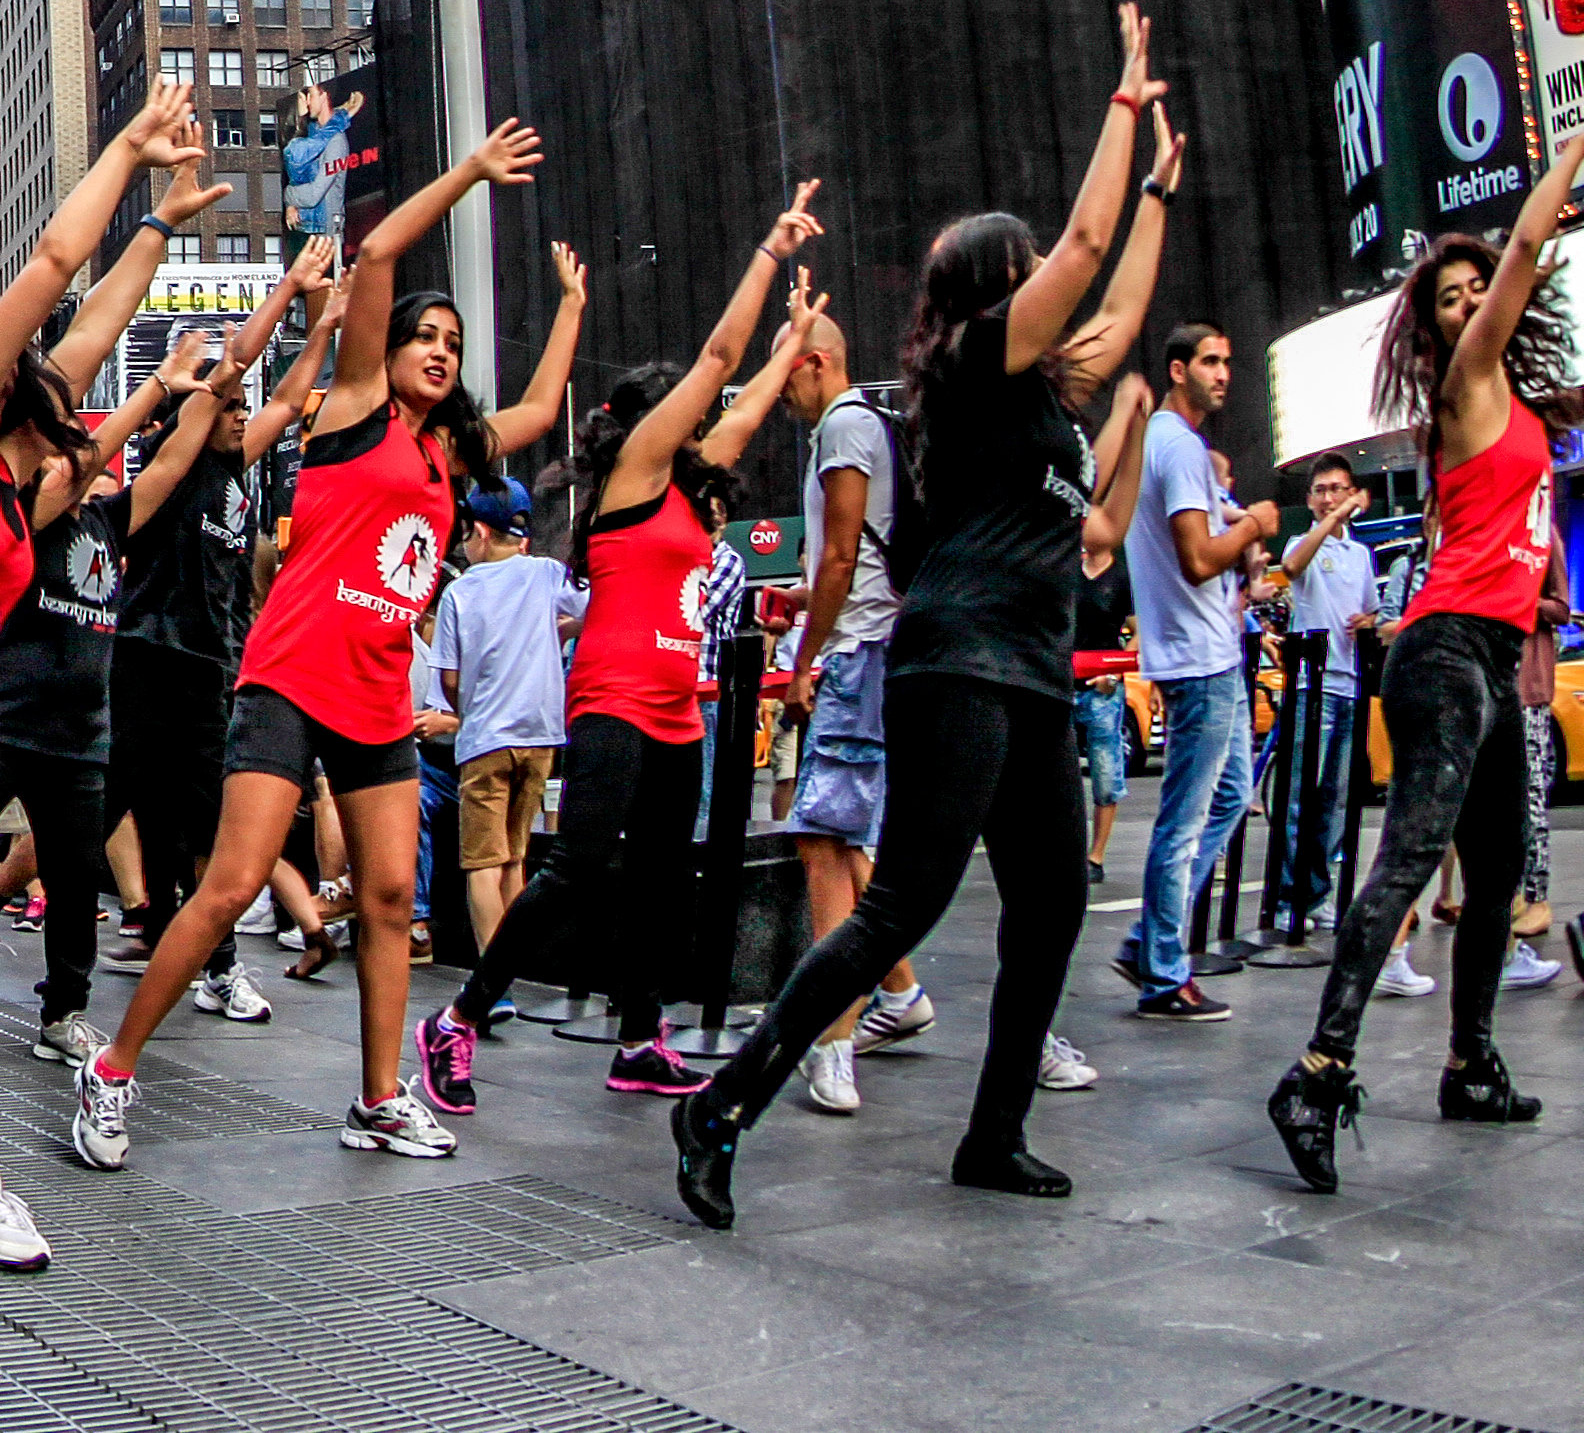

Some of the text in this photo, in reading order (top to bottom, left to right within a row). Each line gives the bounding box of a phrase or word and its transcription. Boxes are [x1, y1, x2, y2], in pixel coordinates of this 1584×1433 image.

[361, 147, 380, 167] IN
[1436, 165, 1520, 213] Lifetime
[231, 272, 279, 282] HOMELAND
[751, 531, 779, 545] CNY
